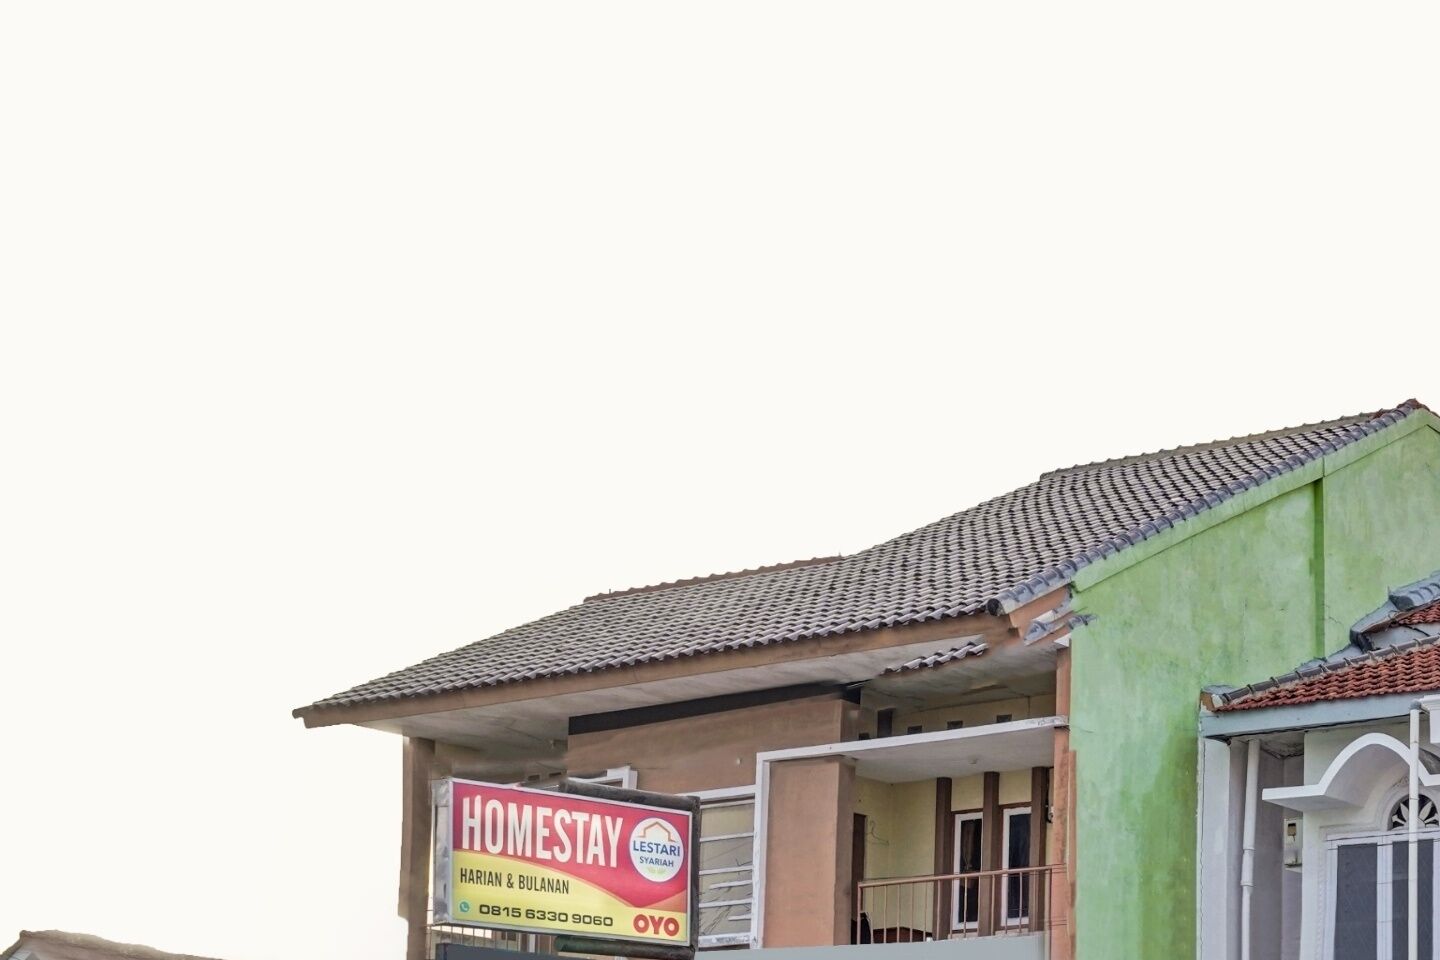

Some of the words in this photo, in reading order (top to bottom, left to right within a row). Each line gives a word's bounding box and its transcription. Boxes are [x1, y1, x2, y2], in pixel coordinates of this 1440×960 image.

[462, 794, 624, 868] HOMESTAY
[633, 840, 681, 857] LESTARI
[639, 855, 675, 868] SYARIAH
[460, 867, 502, 888] HARIAN
[506, 873, 514, 889] &
[518, 875, 570, 894] BULANAN
[479, 904, 522, 918] 0815
[525, 909, 568, 923] 6330
[572, 913, 613, 927] 9060
[633, 913, 680, 937] OYO
